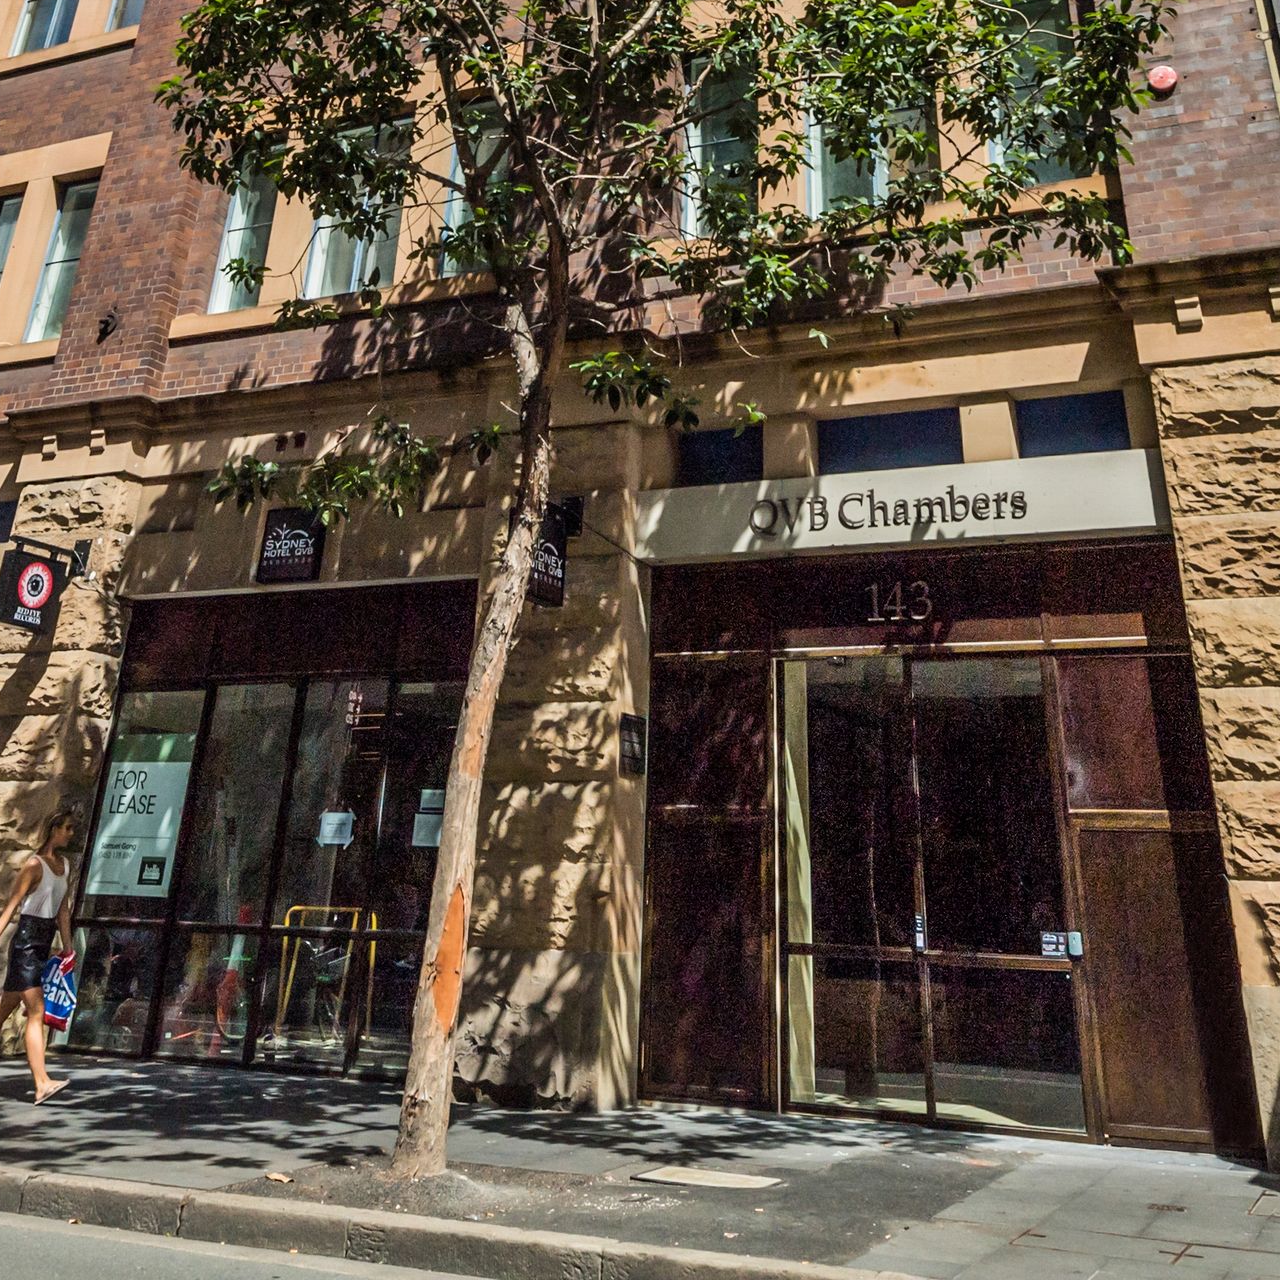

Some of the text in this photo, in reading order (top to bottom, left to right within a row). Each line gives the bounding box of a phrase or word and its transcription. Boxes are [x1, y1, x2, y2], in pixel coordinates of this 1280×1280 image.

[749, 485, 1028, 537] QVB Chambers
[264, 547, 313, 558] HOTEL QVB
[265, 538, 315, 550] SYDNEY
[865, 580, 932, 621] 143
[114, 771, 148, 790] FOR
[109, 795, 157, 814] LEASE
[43, 982, 71, 1008] eans
